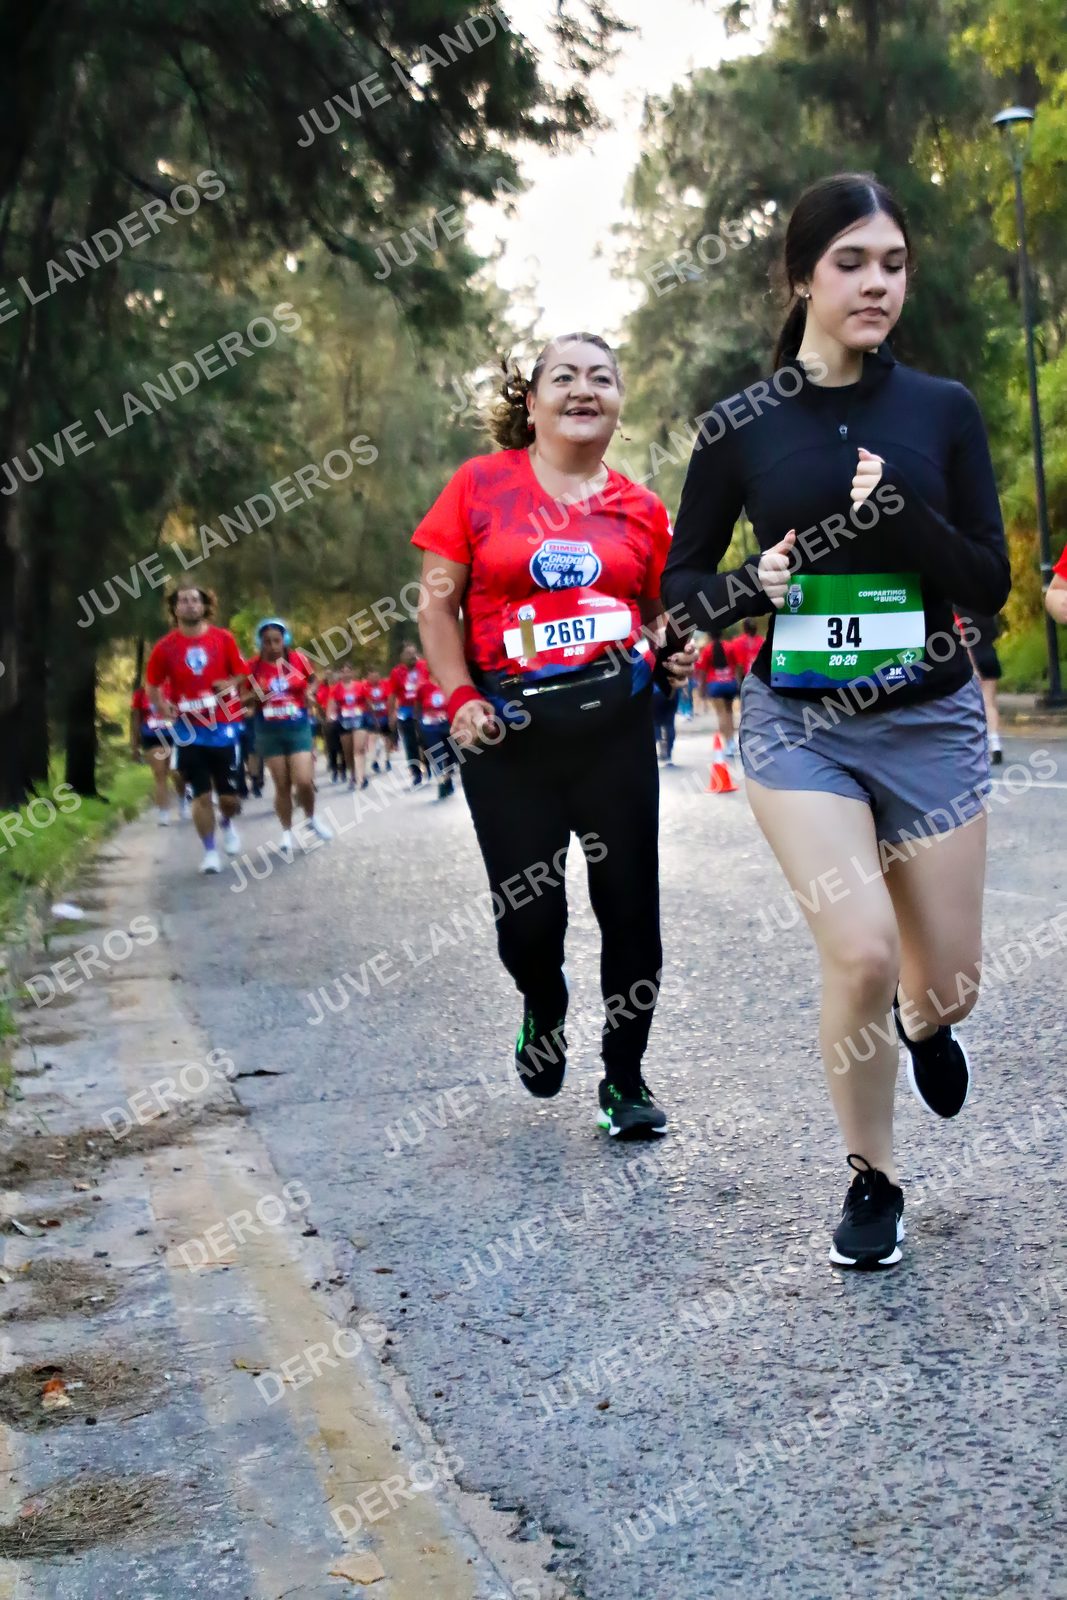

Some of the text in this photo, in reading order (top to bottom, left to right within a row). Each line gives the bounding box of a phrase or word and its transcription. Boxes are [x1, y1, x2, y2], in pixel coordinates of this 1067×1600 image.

[549, 554, 585, 565] Global
[541, 562, 571, 572] Race
[858, 589, 906, 598] COMPARTIMOS
[544, 617, 596, 647] 2667
[827, 617, 862, 648] 34
[889, 667, 903, 676] 3K
